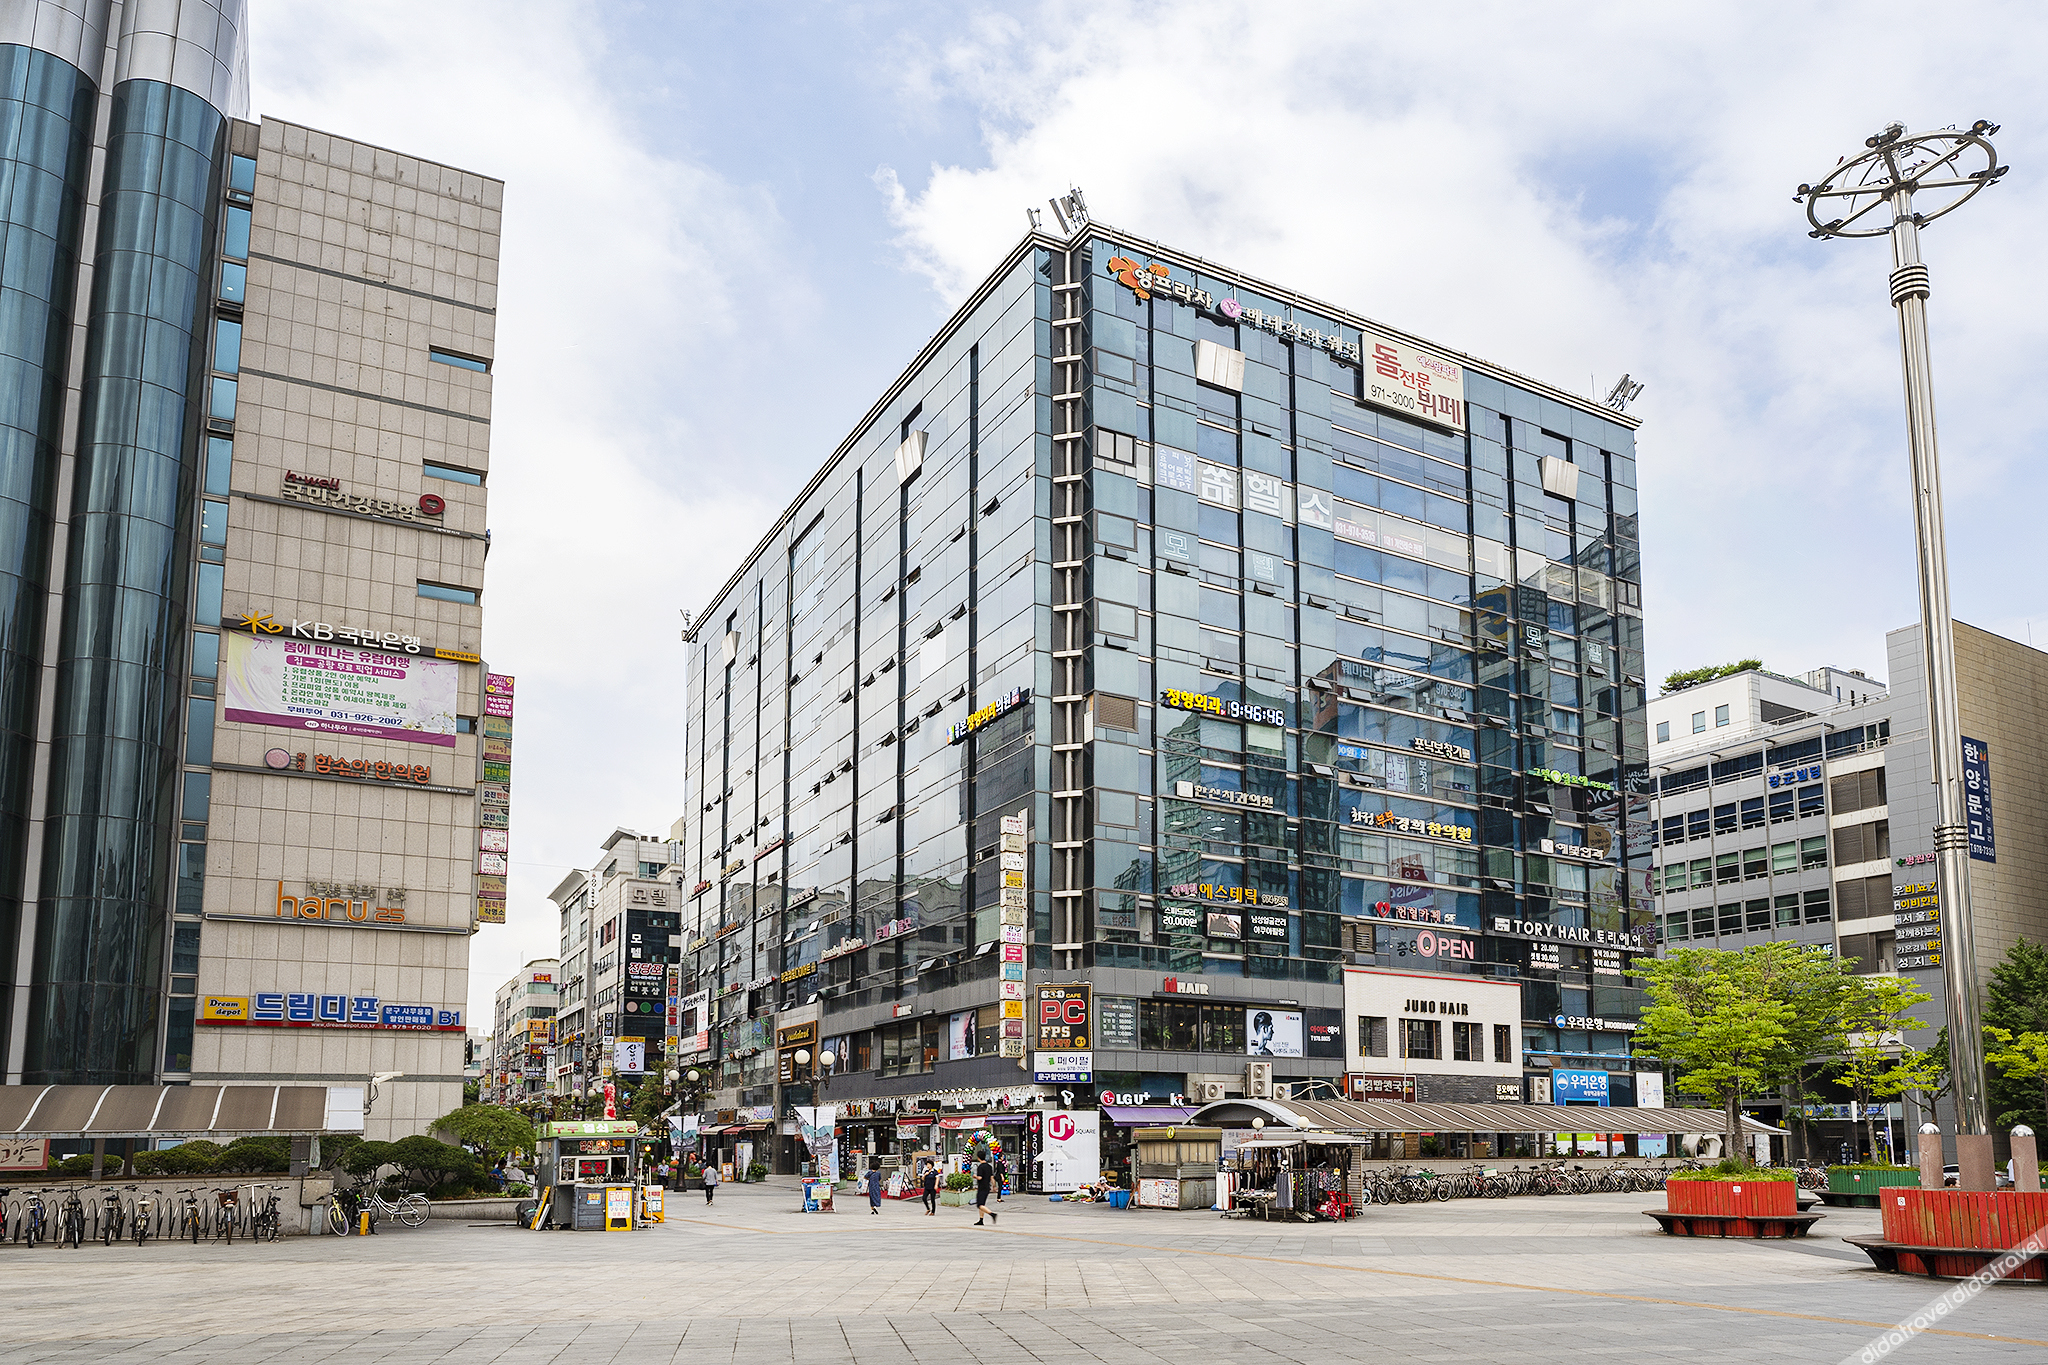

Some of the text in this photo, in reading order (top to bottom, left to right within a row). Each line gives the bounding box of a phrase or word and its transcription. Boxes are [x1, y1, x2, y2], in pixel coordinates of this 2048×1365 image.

[1371, 342, 1432, 391] 돌 전문
[1371, 384, 1416, 410] 971-3000
[1416, 390, 1461, 426] 뷔페
[292, 618, 421, 655] KB 국민은행
[284, 641, 410, 669] 봄에 떠나는 유럽여행
[1166, 687, 1222, 715] 정형외과
[330, 711, 404, 726] 031-926-2002
[1230, 701, 1286, 727] 9:46:46
[314, 753, 431, 785] 함소아한의원
[1768, 764, 1822, 789] 장군빌딩
[276, 880, 367, 922] haru
[374, 906, 405, 922] 25
[631, 887, 668, 907] 모텔
[1199, 883, 1258, 905] 에스테틱
[1513, 919, 1642, 947] TORY HAIR 토리헤어
[1416, 929, 1474, 961] OPEN
[628, 961, 664, 977] 전당포
[1176, 980, 1209, 996] HAIR
[208, 998, 240, 1008] Dream
[215, 1007, 243, 1018] depot
[253, 992, 381, 1024] 드림디포
[1040, 999, 1086, 1025] PC
[1404, 998, 1469, 1017] JUNO HAIR
[437, 1009, 461, 1026] B1
[1567, 1015, 1604, 1031] 우리은행
[1041, 1026, 1071, 1039] FPS
[1570, 1073, 1607, 1090] 우리은행
[1169, 1092, 1184, 1106] kt
[553, 1122, 580, 1134] 구두
[612, 1124, 637, 1134] 도장
[581, 1161, 607, 1174] 도장
